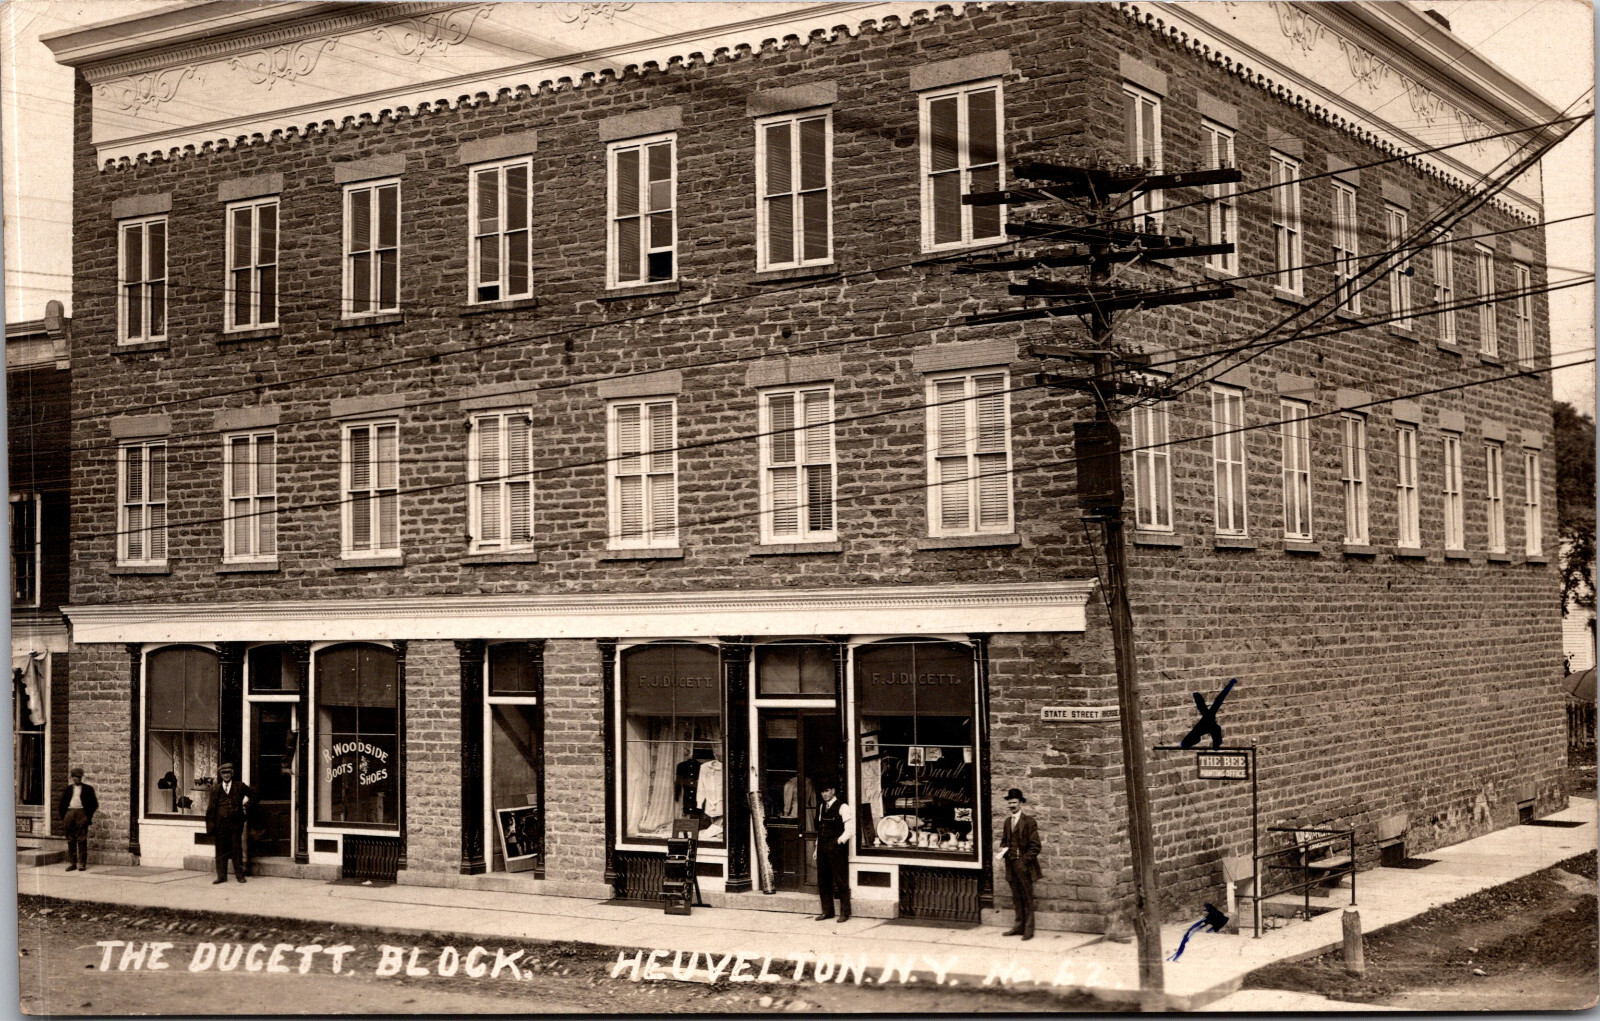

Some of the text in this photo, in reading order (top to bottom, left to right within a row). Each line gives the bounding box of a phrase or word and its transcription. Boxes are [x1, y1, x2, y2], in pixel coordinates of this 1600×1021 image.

[1044, 710, 1067, 718] STATE
[1071, 711, 1099, 719] STREET
[322, 742, 388, 763] R. WOODSIDE
[1199, 756, 1246, 767] THE BEE
[360, 768, 388, 785] SHOES
[1225, 769, 1247, 778] OFFICE
